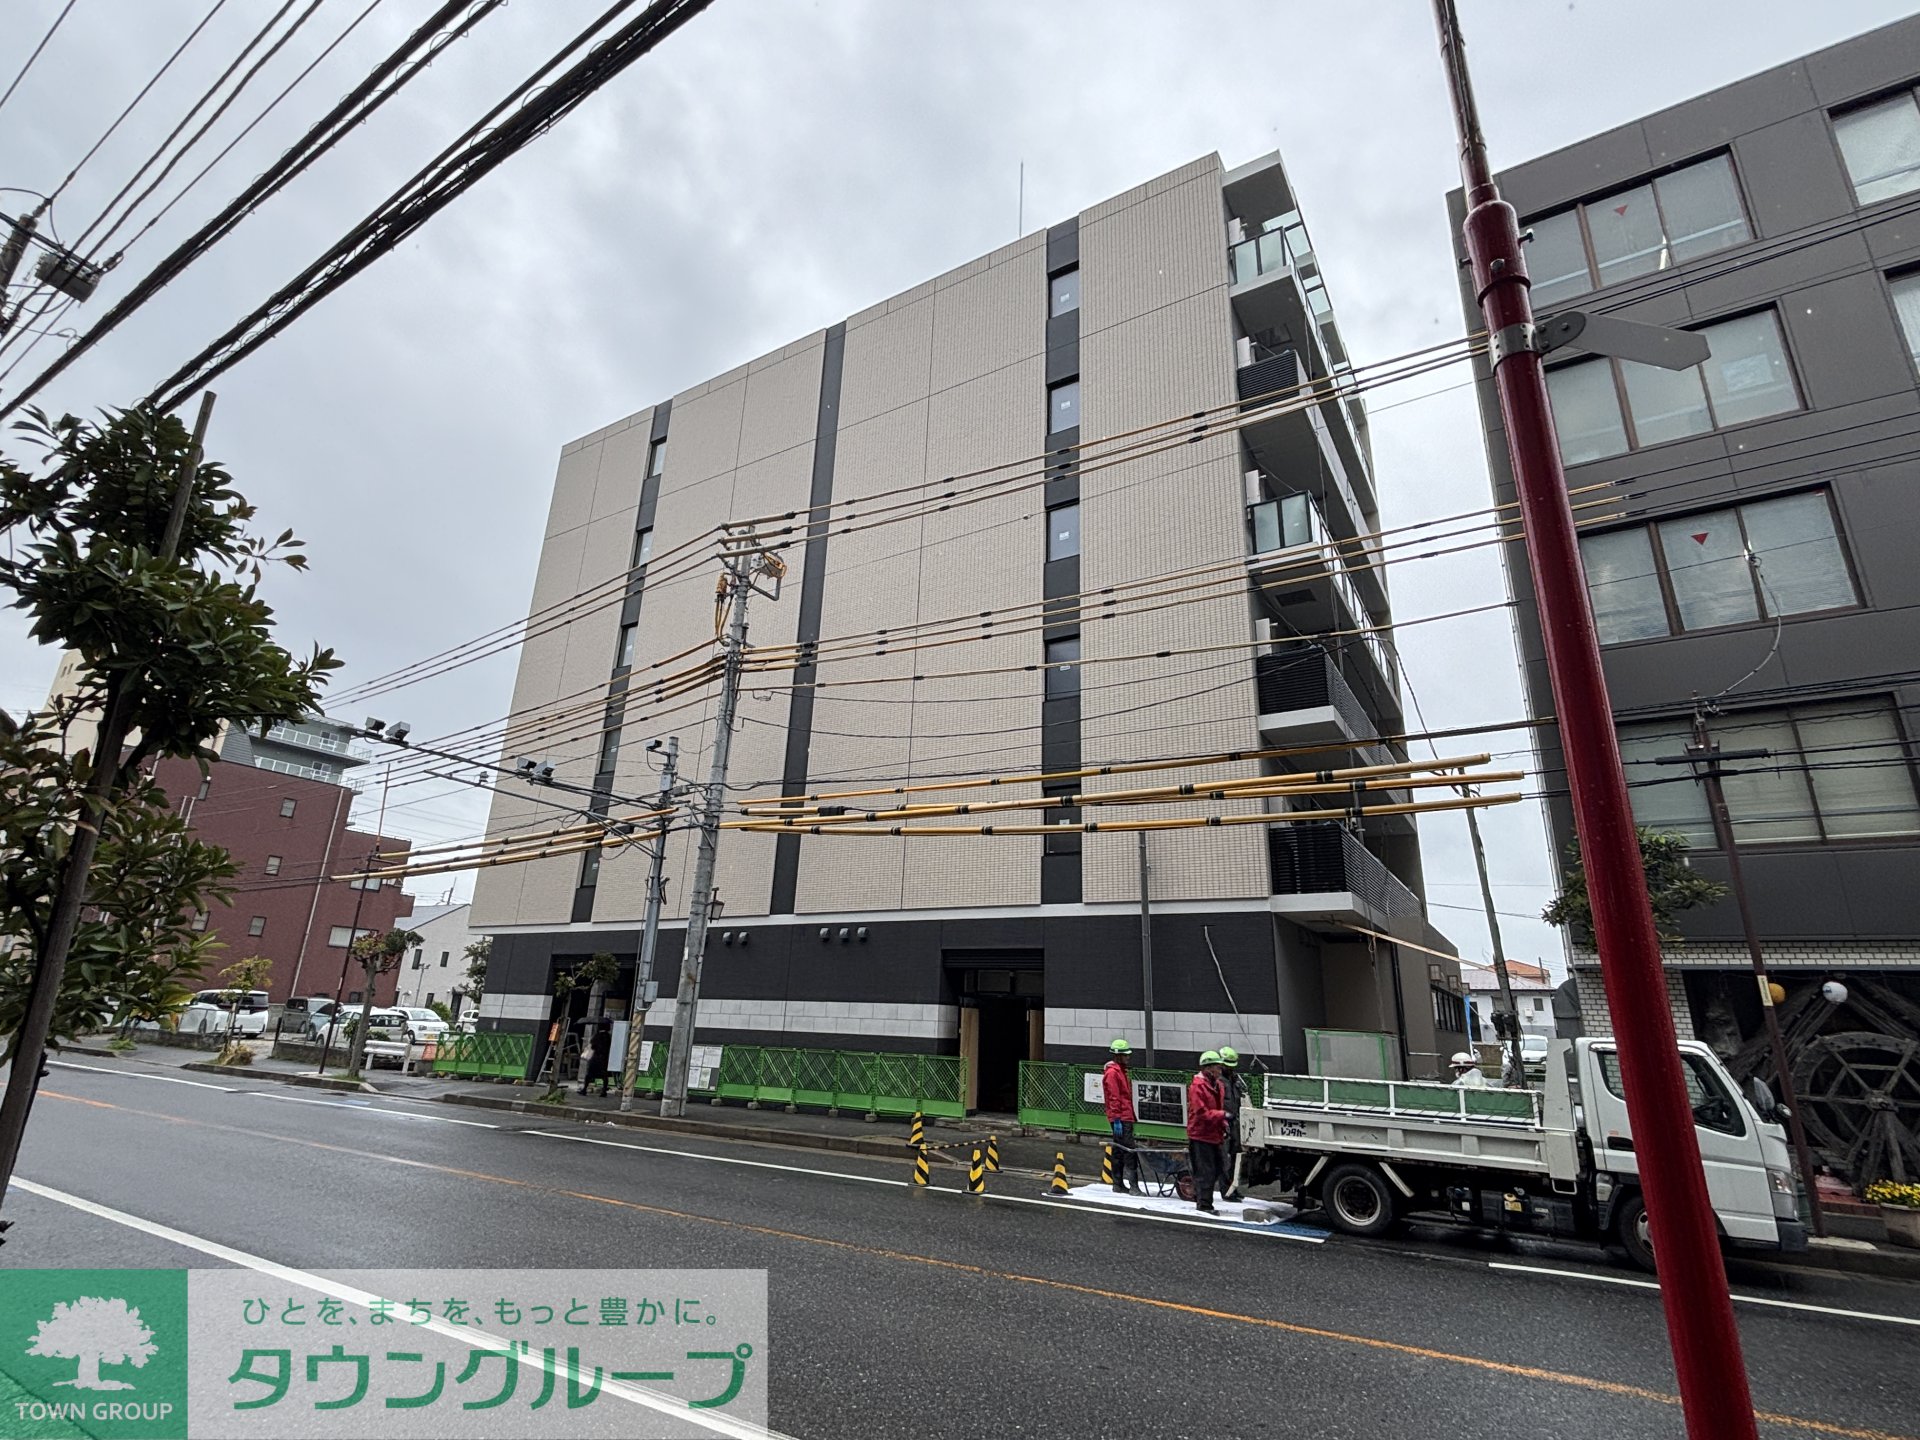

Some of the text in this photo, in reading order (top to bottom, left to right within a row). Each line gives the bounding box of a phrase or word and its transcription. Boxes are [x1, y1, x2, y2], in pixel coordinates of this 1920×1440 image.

[1280, 1127, 1307, 1137] レンタカー
